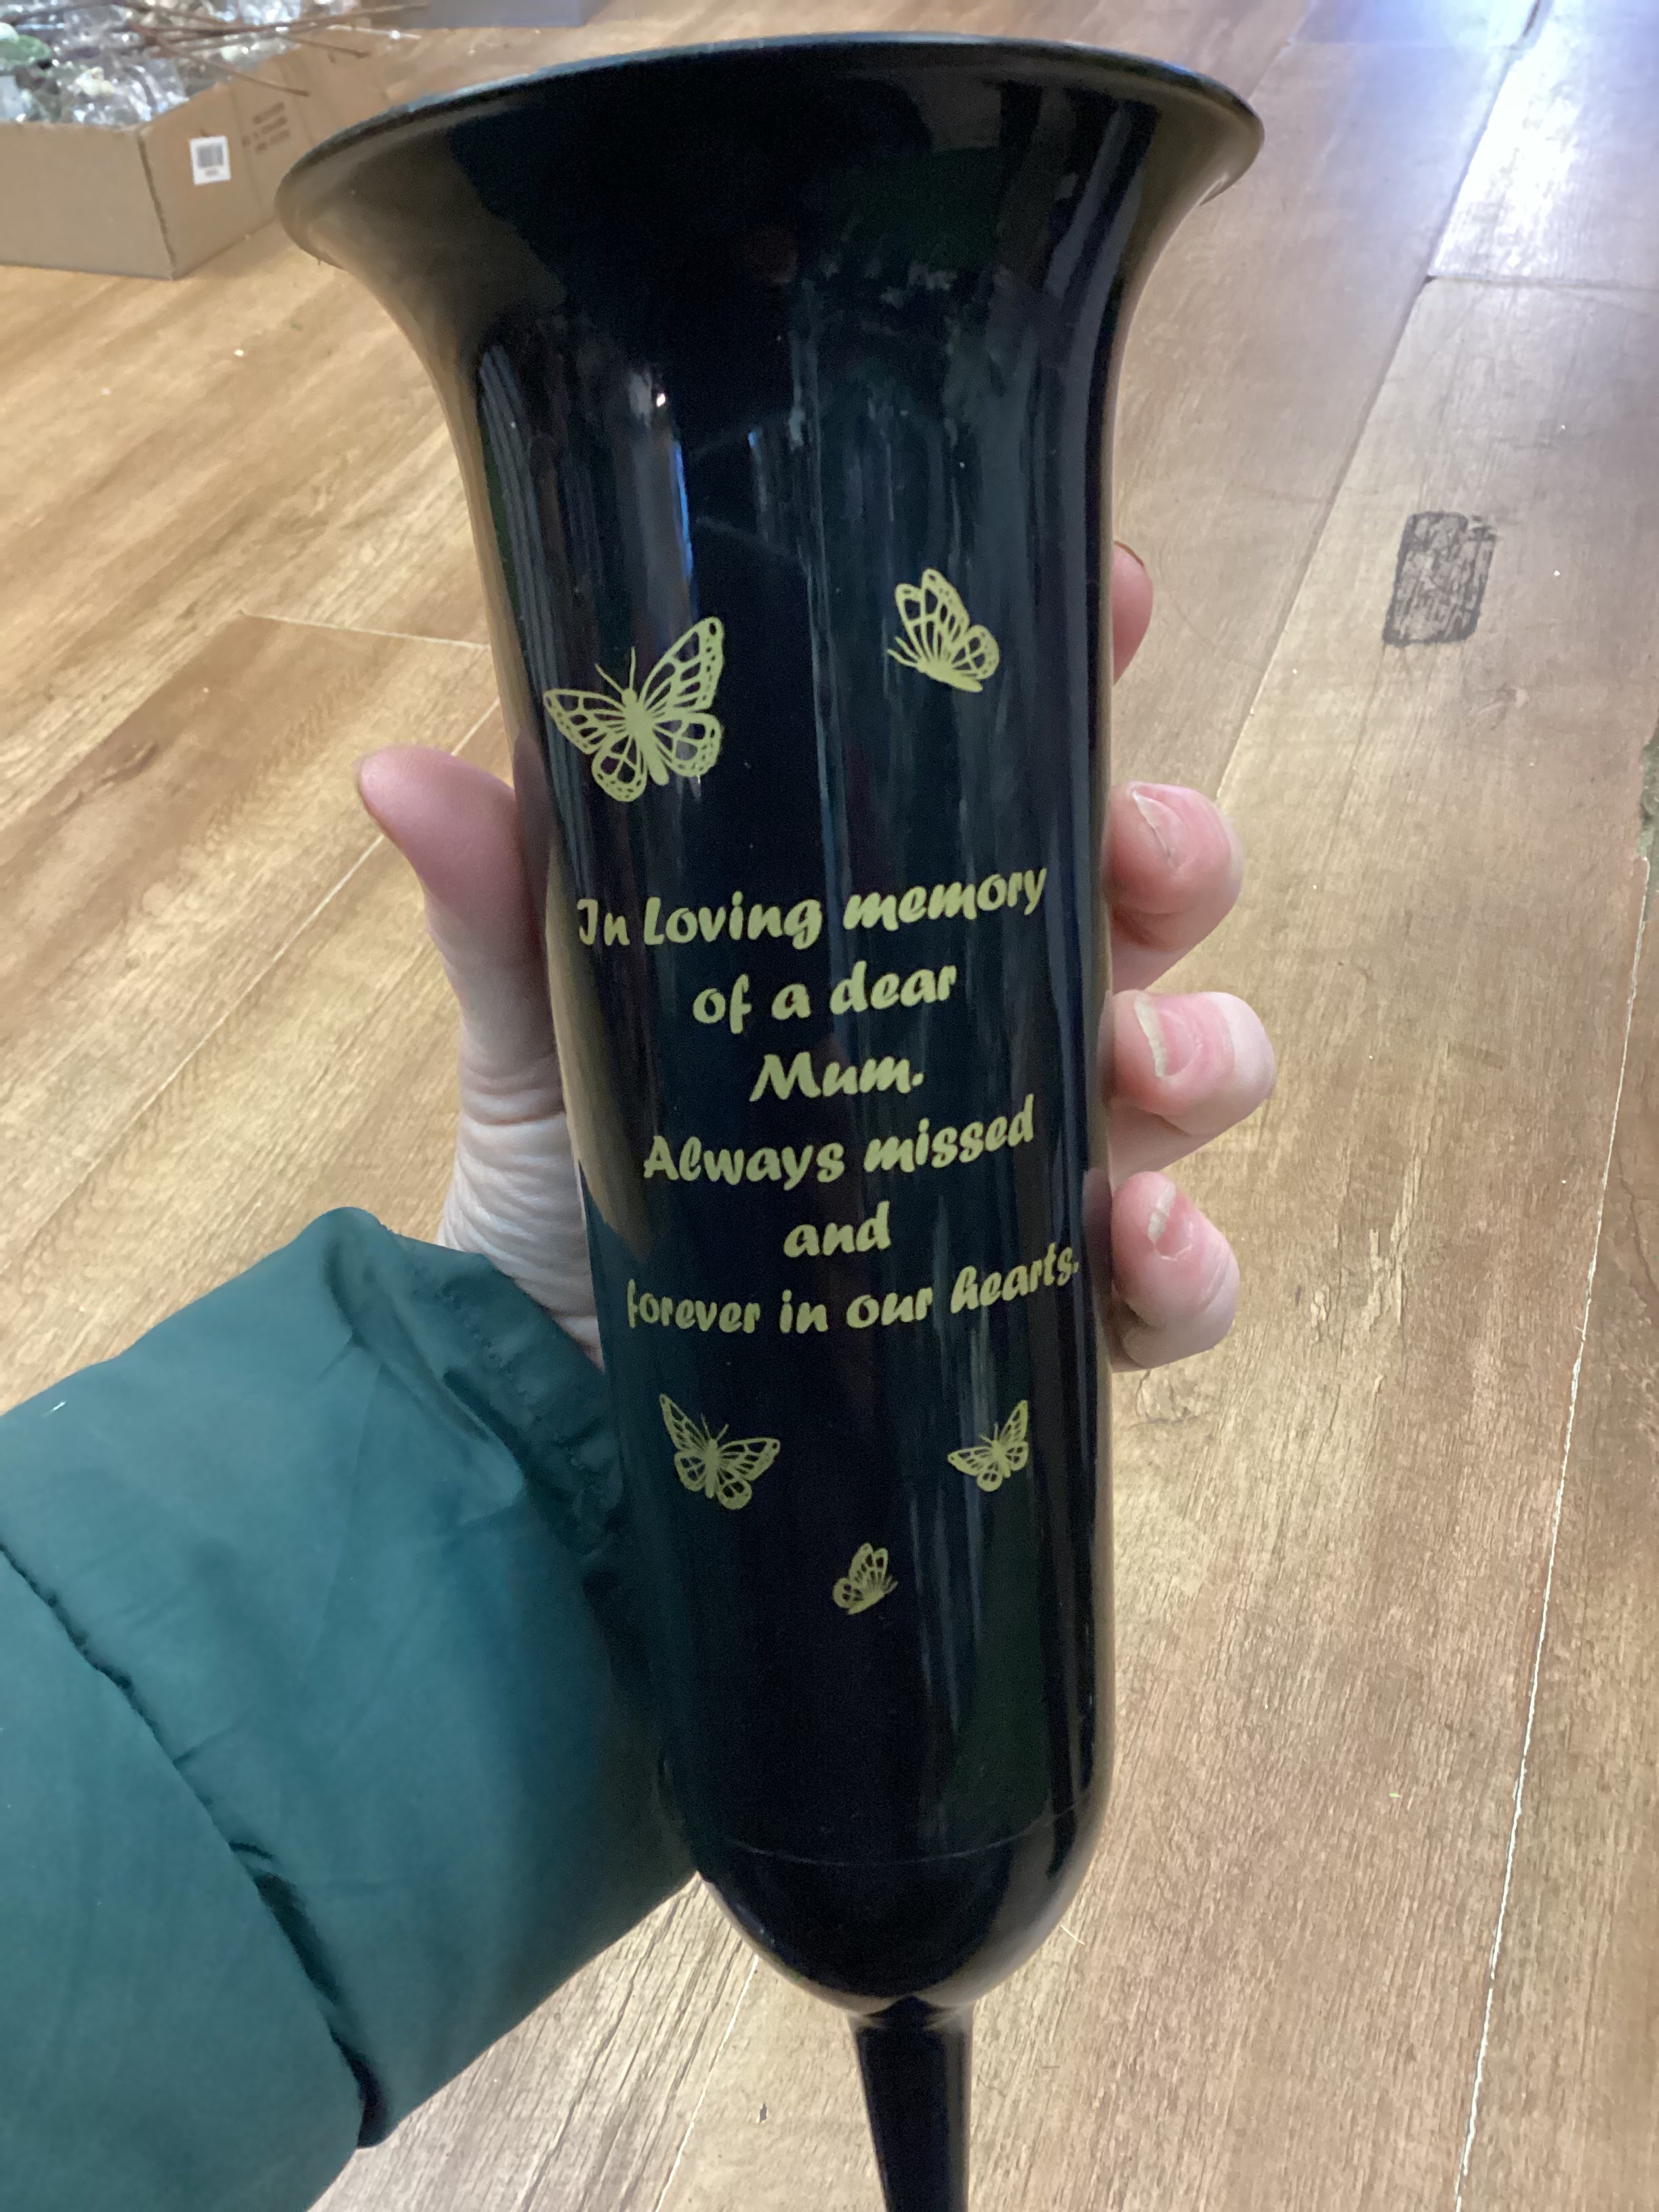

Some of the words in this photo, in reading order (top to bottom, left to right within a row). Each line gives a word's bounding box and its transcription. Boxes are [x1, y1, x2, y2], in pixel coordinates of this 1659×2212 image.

[578, 899, 630, 946] In
[644, 891, 823, 949] Loving
[843, 868, 1048, 930] memory
[693, 975, 752, 1034] of
[771, 984, 812, 1020] a
[830, 960, 957, 1015] dear
[750, 1052, 924, 1101] Mum.
[643, 1136, 844, 1190] Always
[863, 1094, 1034, 1172] missed
[783, 1201, 891, 1257] and
[779, 1290, 829, 1333] in
[846, 1287, 933, 1329] our
[950, 1243, 1079, 1314] hearts.
